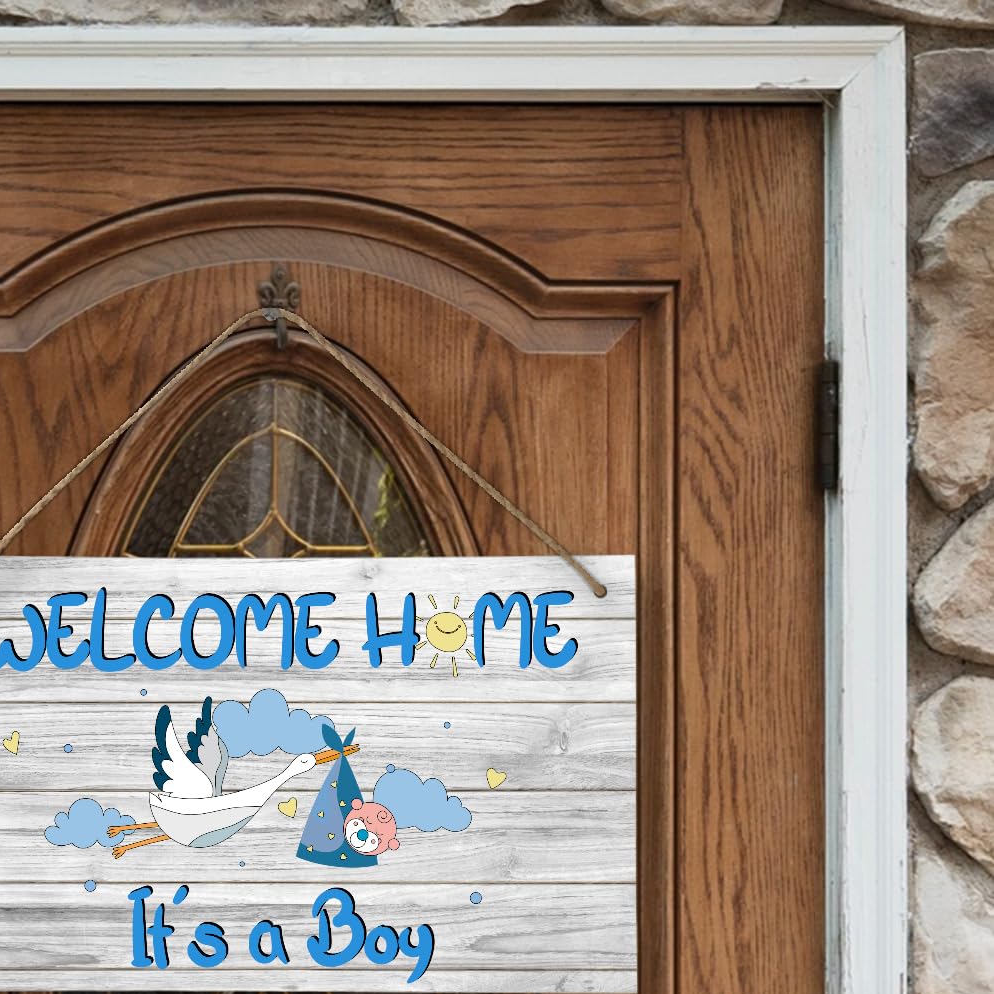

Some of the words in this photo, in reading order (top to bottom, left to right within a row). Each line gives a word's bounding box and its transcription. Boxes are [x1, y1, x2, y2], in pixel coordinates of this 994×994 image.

[361, 591, 579, 674] HOME
[127, 885, 229, 969] It's
[248, 919, 291, 965] a
[306, 887, 436, 984] Boy
